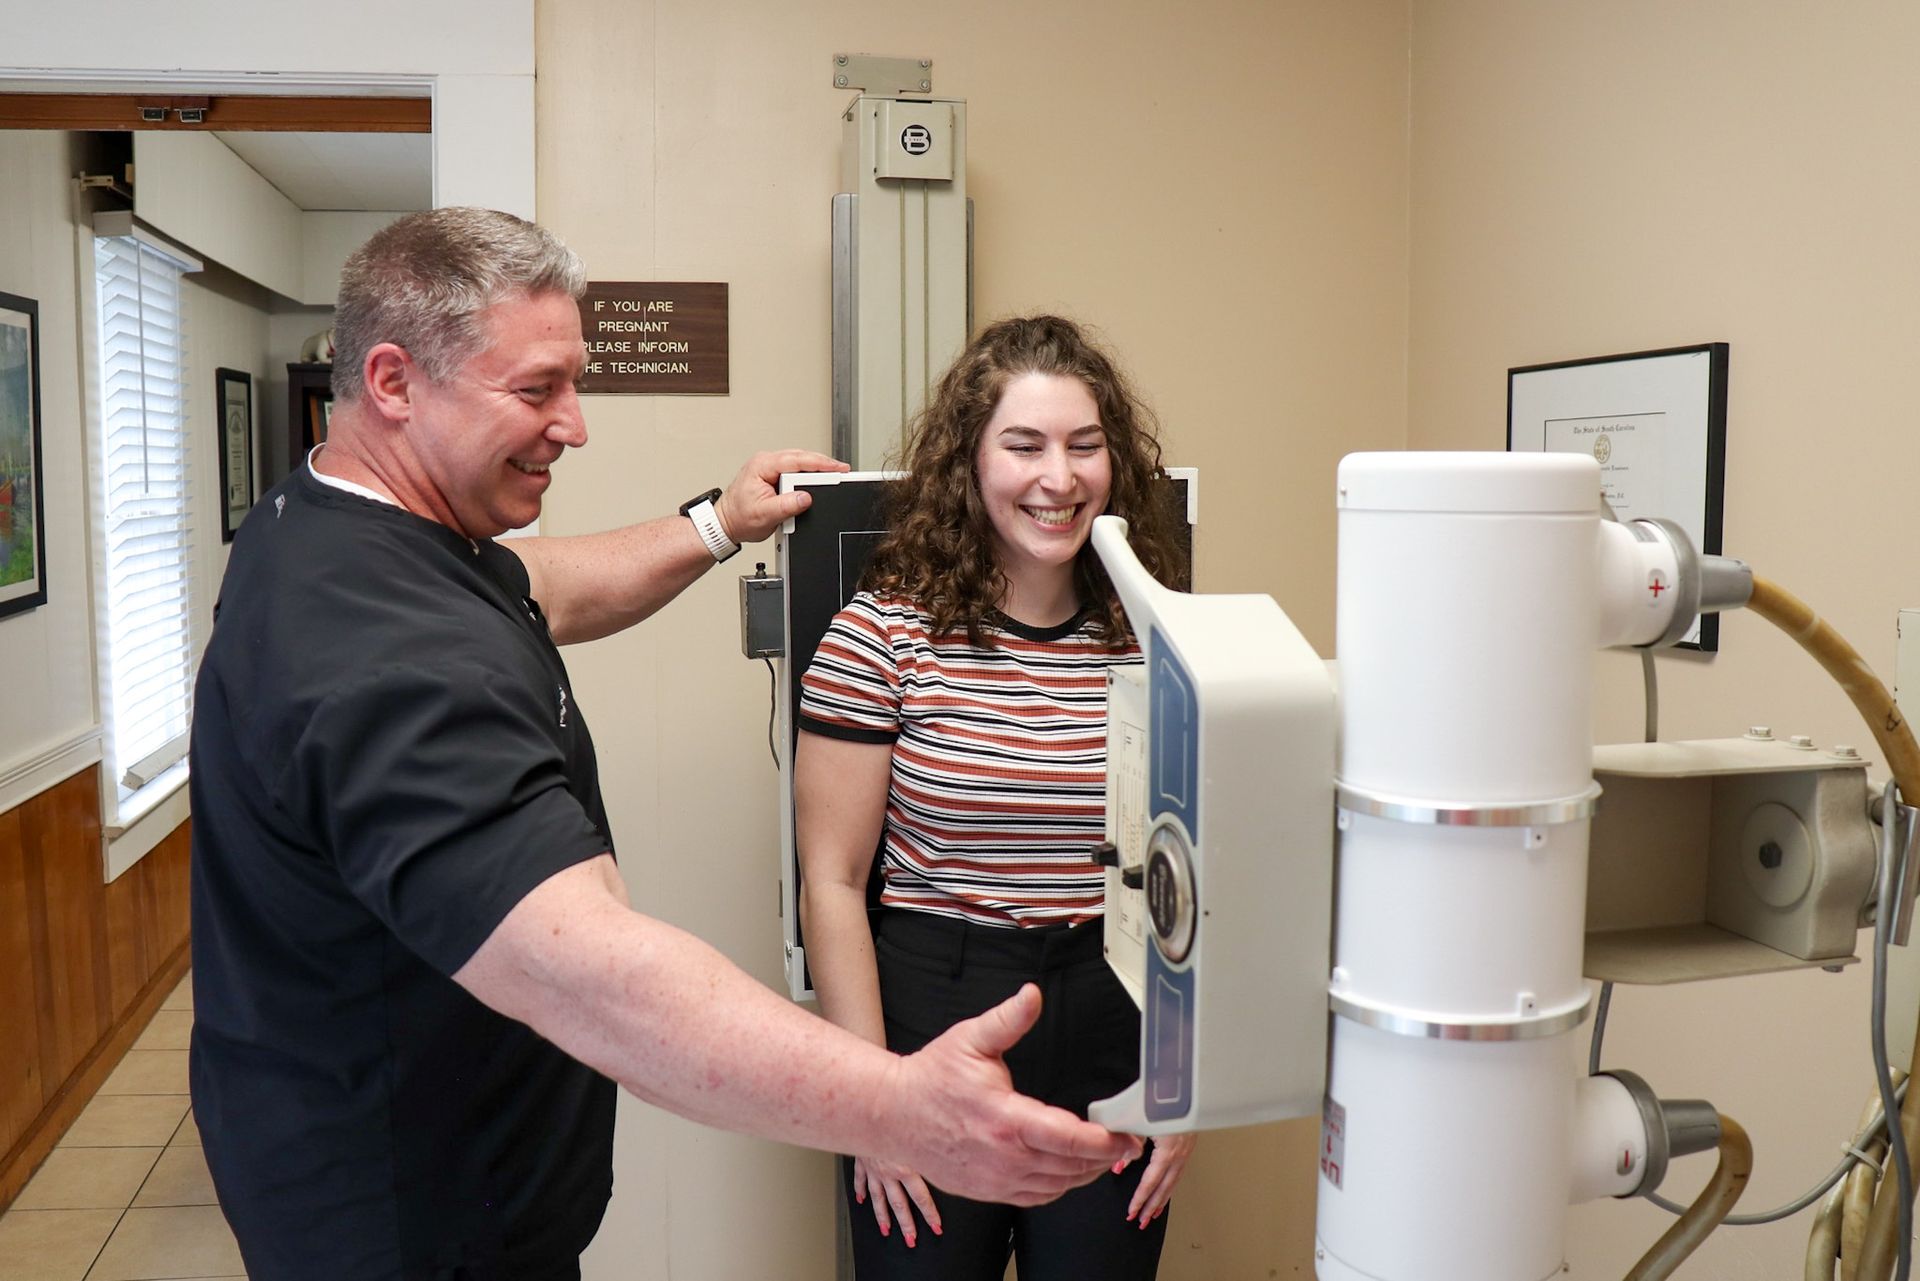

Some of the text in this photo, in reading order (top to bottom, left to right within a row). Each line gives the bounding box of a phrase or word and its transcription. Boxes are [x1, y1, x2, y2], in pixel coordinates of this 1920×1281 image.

[594, 301, 674, 312] IF YOU ARE
[598, 321, 669, 332] PREGNANT
[638, 341, 689, 353] INFORM
[585, 362, 692, 373] HE TECHNICIAN.
